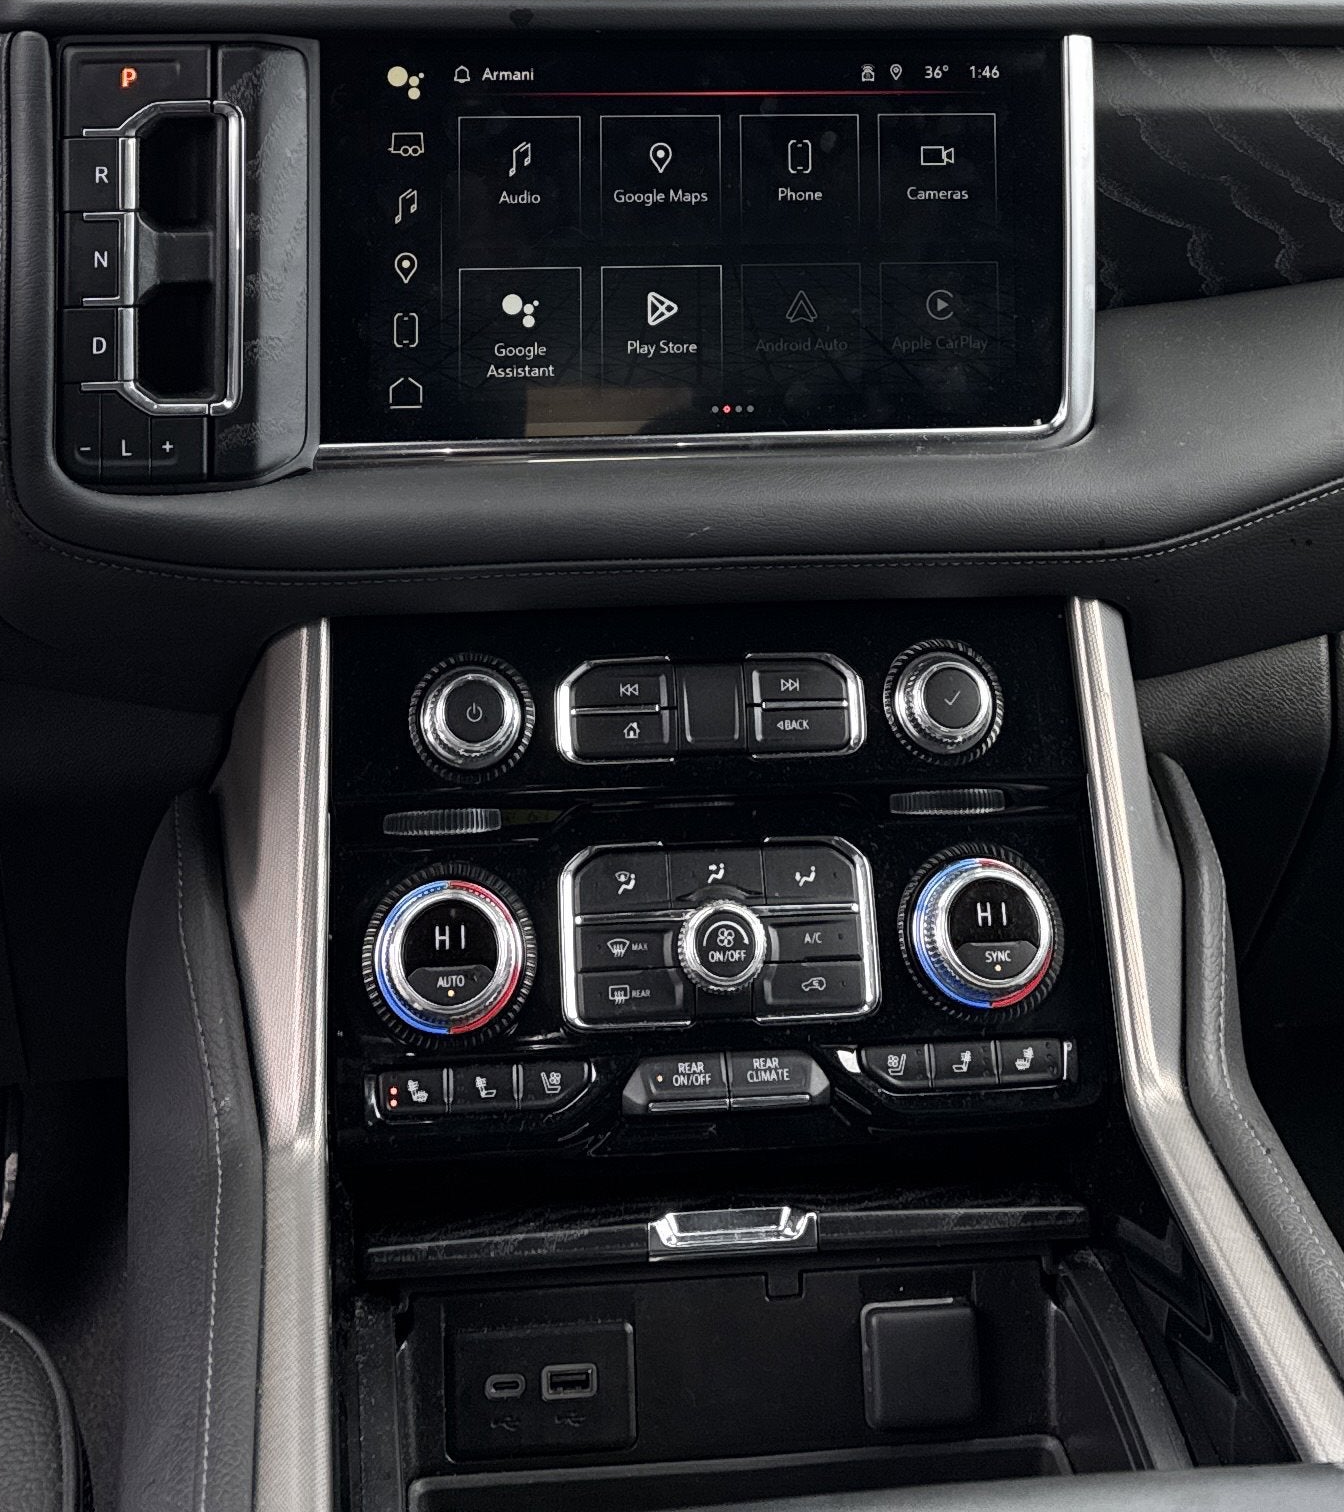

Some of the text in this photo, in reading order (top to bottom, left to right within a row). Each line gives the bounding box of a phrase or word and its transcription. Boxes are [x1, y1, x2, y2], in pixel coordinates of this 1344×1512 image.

[121, 67, 137, 88] P
[481, 67, 534, 81] Armani
[969, 65, 1000, 79] 1:46
[95, 166, 109, 184] R
[498, 189, 541, 205] Audio
[613, 188, 708, 207] Google Maps
[778, 187, 823, 201] Phone
[906, 186, 969, 200] Cameras
[94, 250, 108, 268] N
[92, 336, 107, 355] D
[494, 341, 547, 361] Google
[627, 339, 698, 358] Play Store
[756, 337, 848, 352] Android Auto
[892, 335, 988, 353] Apple CarPlay
[486, 364, 555, 378] Assistant
[121, 439, 132, 457] L
[784, 719, 810, 731] BACK
[976, 901, 1007, 927] HI
[434, 924, 466, 951] HI
[804, 931, 823, 944] A/C
[631, 942, 648, 951] MAX
[708, 949, 747, 963] ON/OFF
[985, 949, 1012, 963] SYNC
[436, 974, 465, 988] AUTO
[631, 989, 651, 998] REAR
[677, 1061, 706, 1076] REAR
[752, 1057, 782, 1073] REAR
[672, 1070, 712, 1087] ON/OFF
[746, 1065, 791, 1083] CLIMATE
